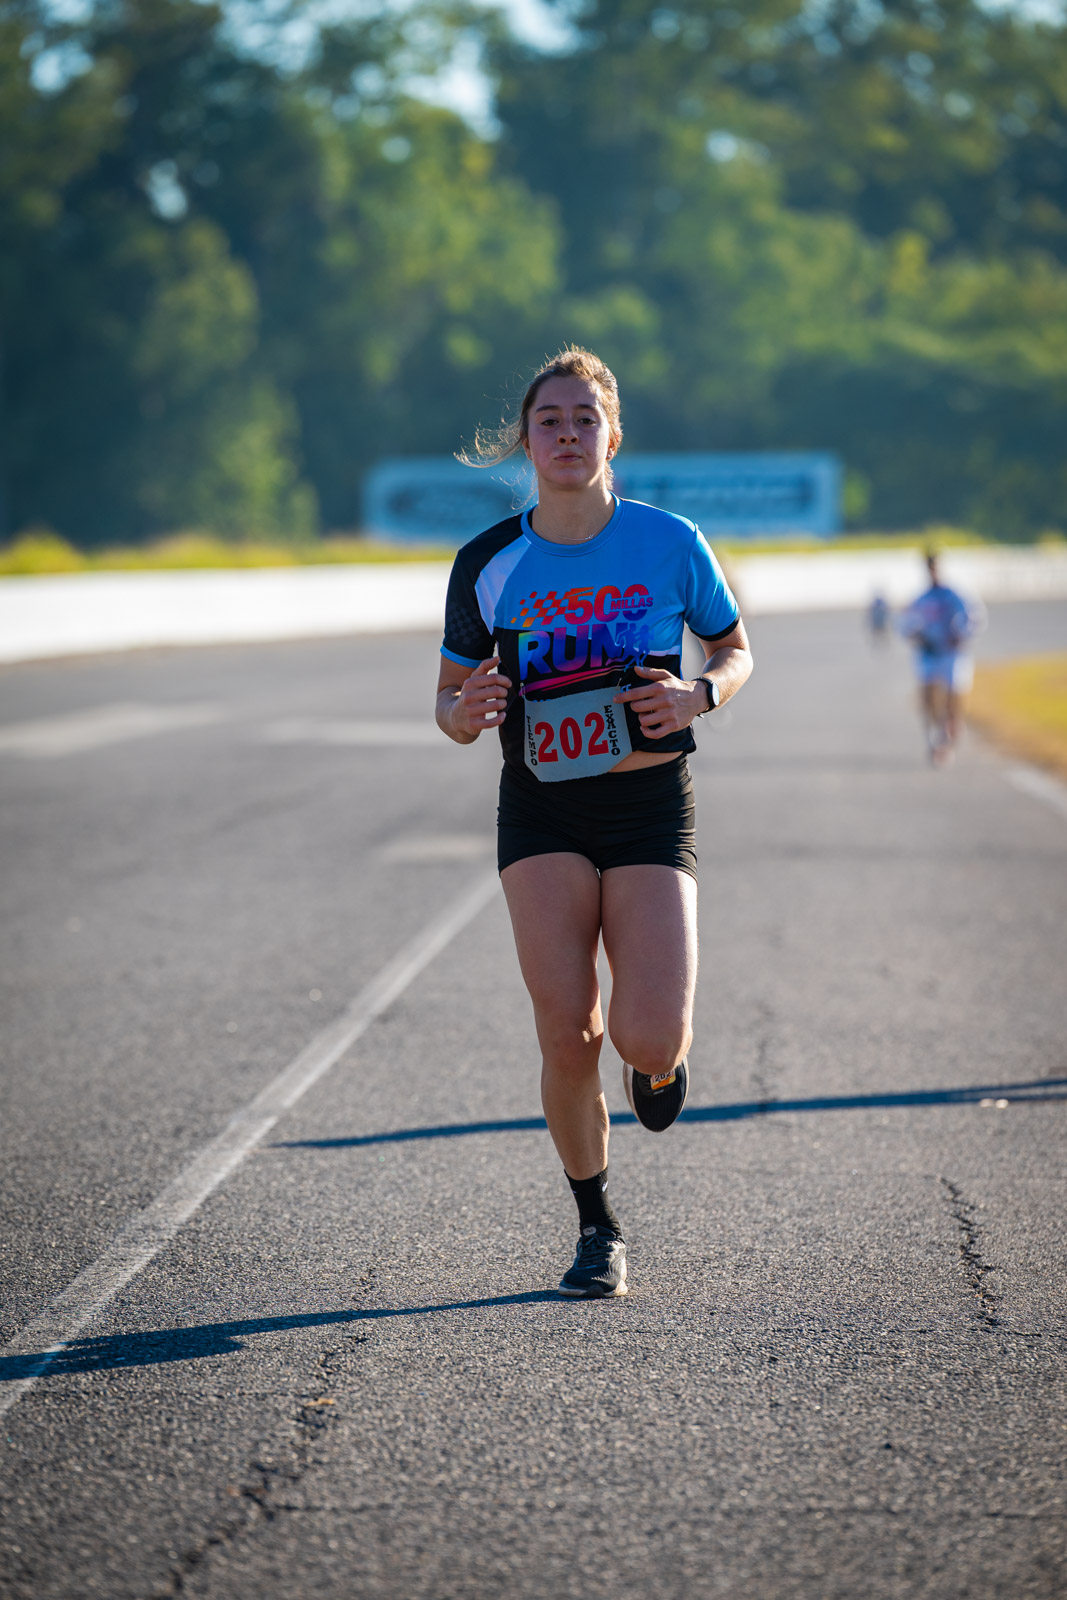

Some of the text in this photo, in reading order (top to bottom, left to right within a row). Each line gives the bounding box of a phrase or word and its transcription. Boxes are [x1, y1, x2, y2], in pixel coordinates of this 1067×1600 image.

[610, 597, 654, 610] MILLAS
[518, 623, 630, 680] RUN
[526, 715, 538, 766] TIEMPO
[534, 712, 609, 763] 202
[604, 705, 620, 756] EXACTO
